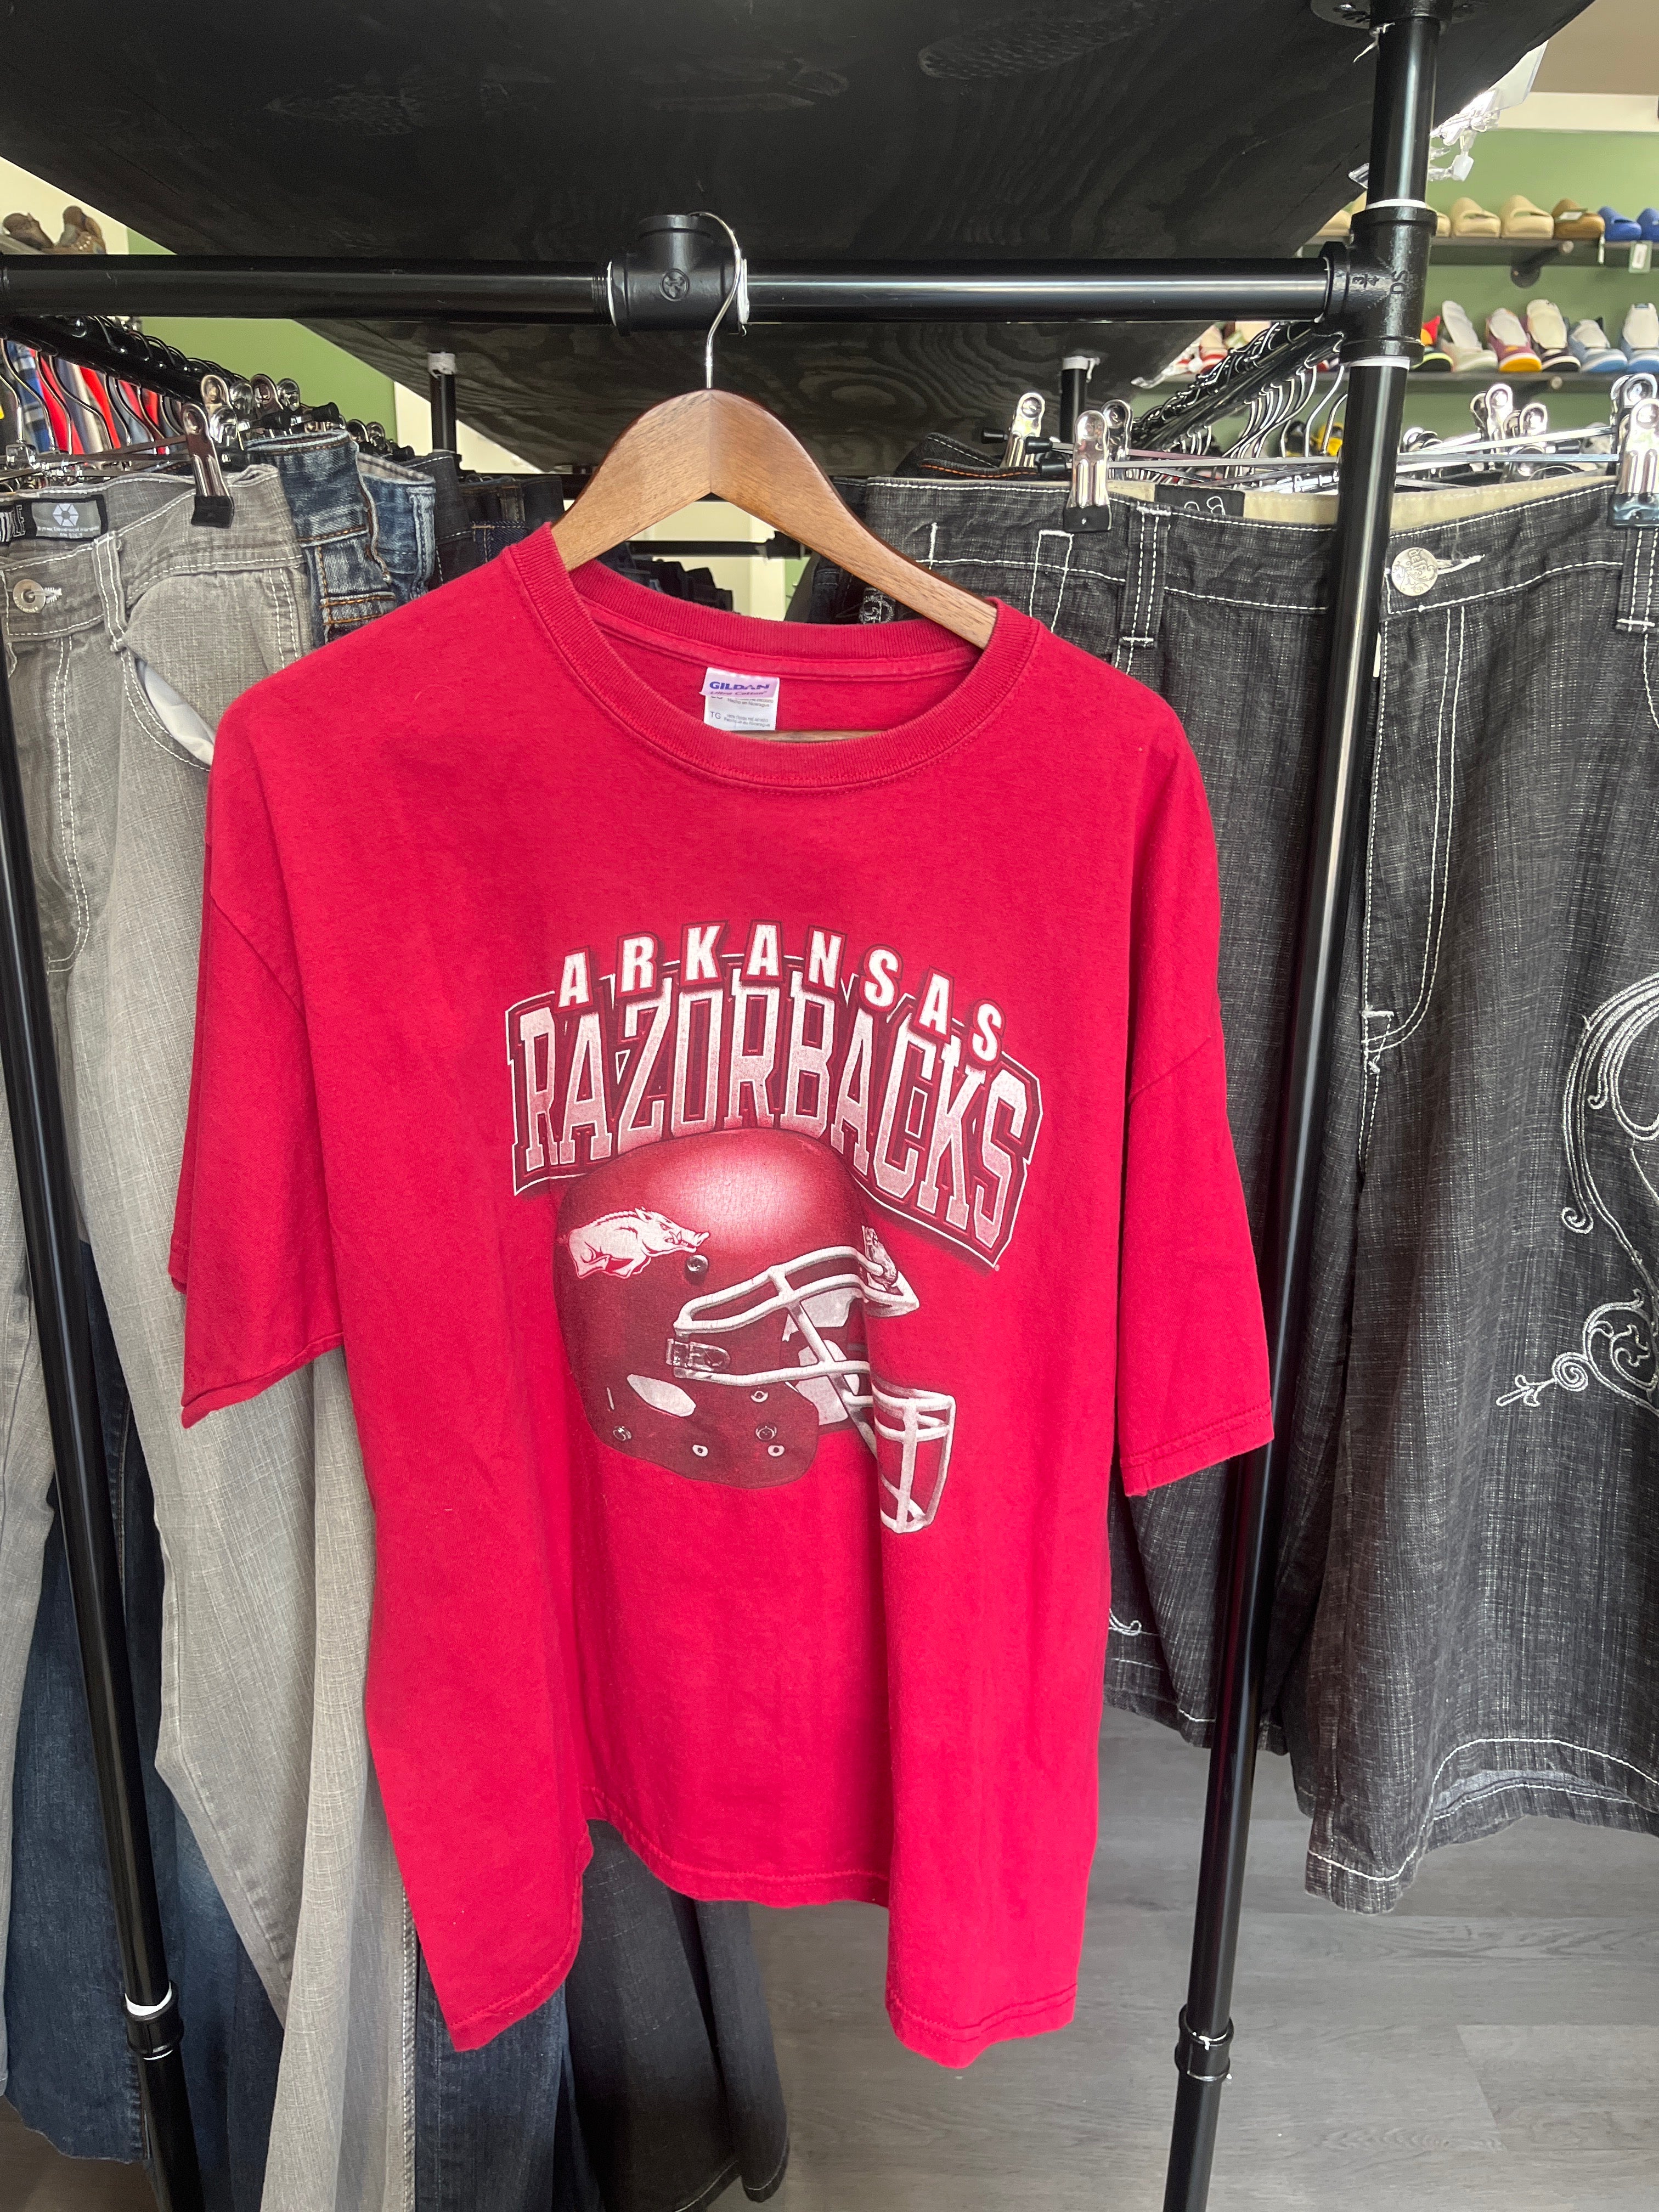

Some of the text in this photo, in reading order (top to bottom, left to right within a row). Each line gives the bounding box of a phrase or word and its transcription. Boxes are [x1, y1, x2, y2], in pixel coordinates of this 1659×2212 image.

[709, 681, 770, 690] GILDAN
[710, 711, 721, 719] TG
[556, 922, 1003, 1063] ARKANSAS
[515, 977, 1034, 1254] RAZORBACKS
